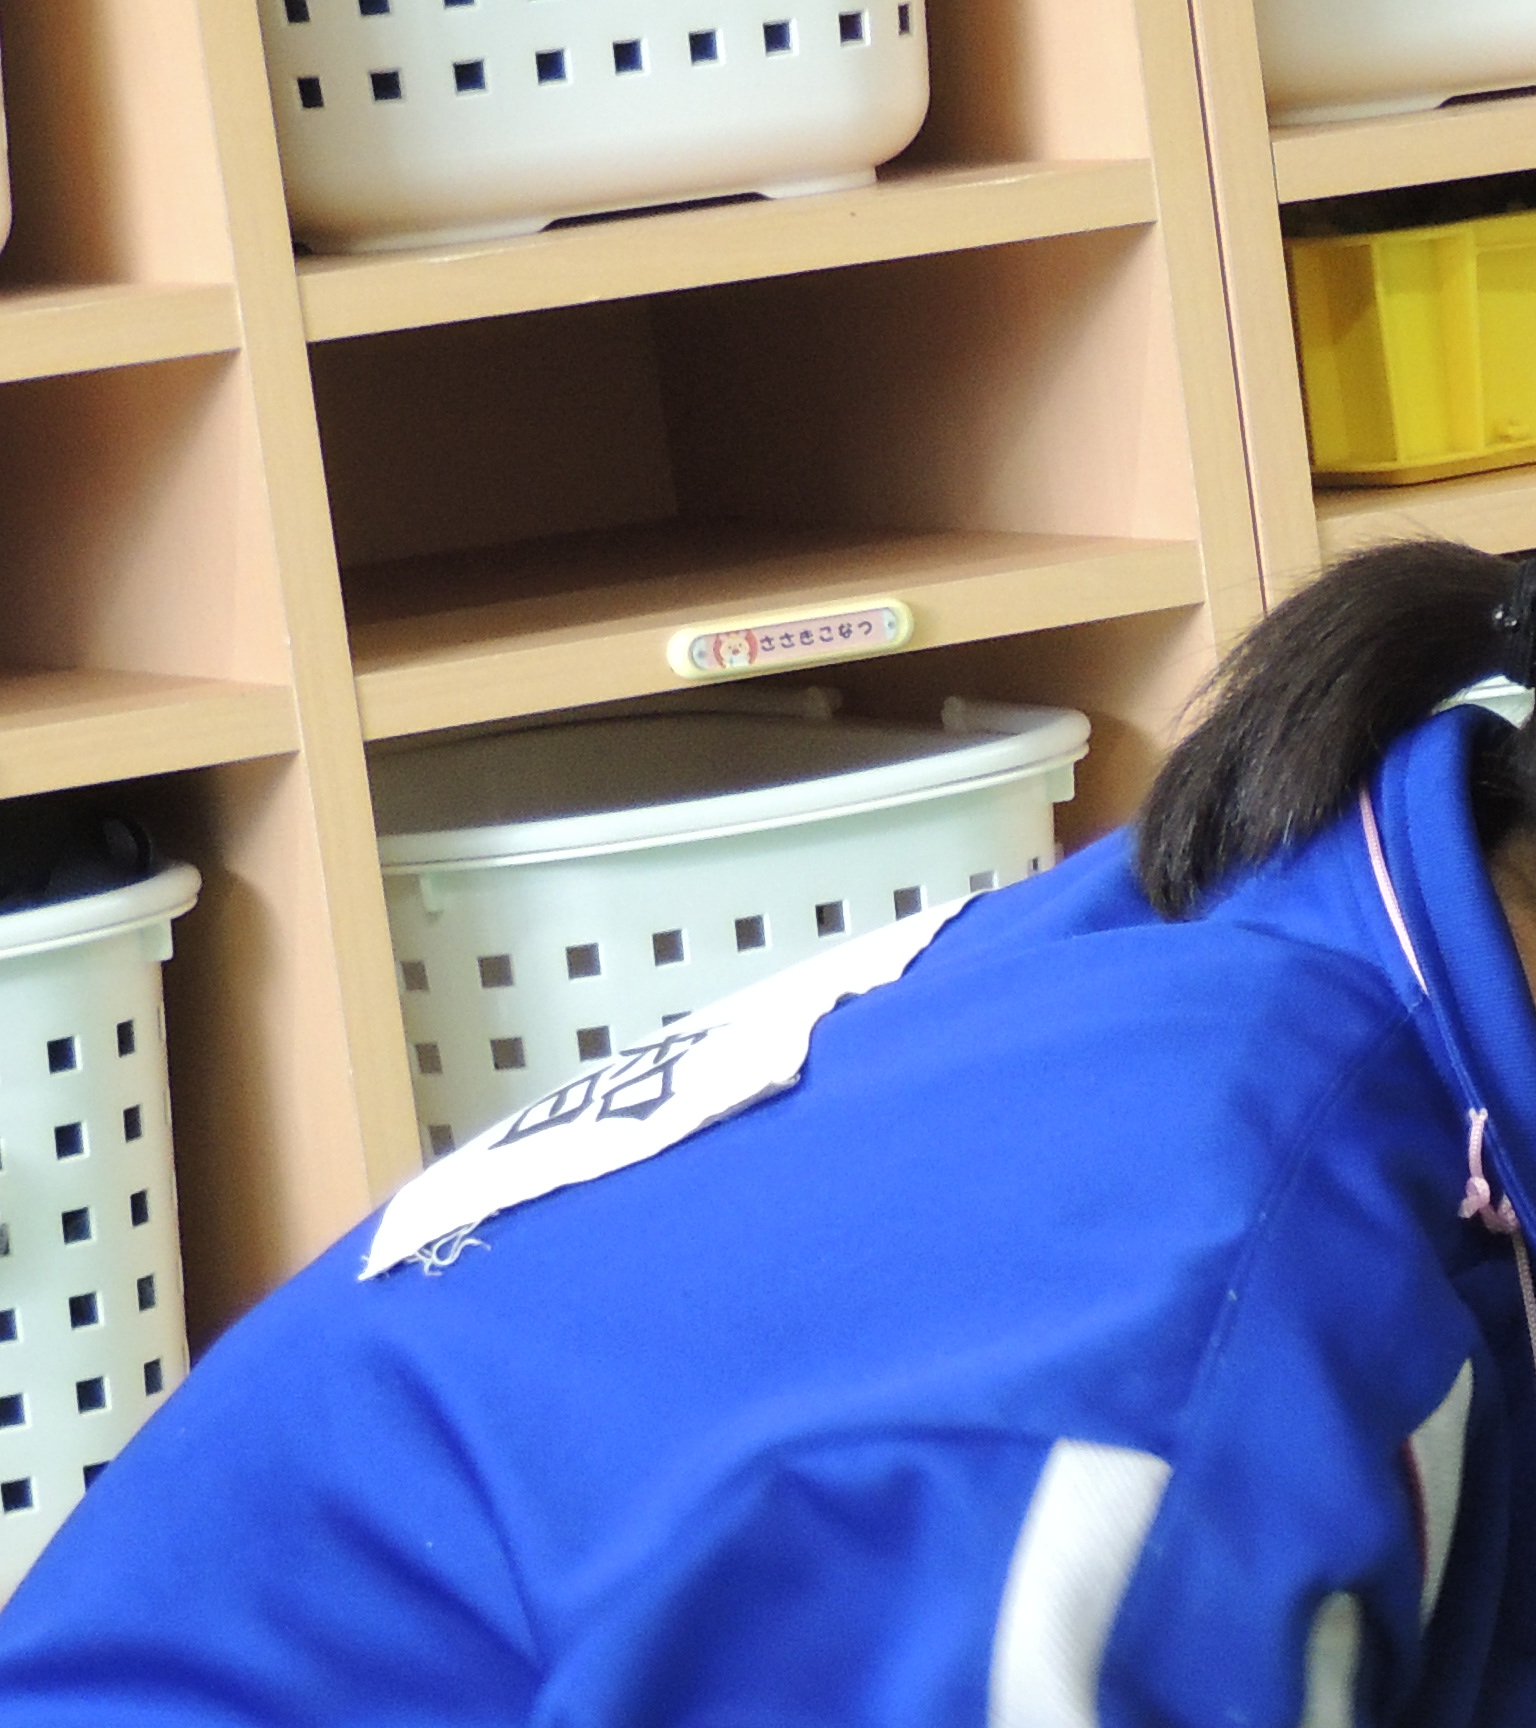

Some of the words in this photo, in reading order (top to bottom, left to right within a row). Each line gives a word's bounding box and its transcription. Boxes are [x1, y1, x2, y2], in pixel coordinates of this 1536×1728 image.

[759, 620, 873, 652] ささきこなつ
